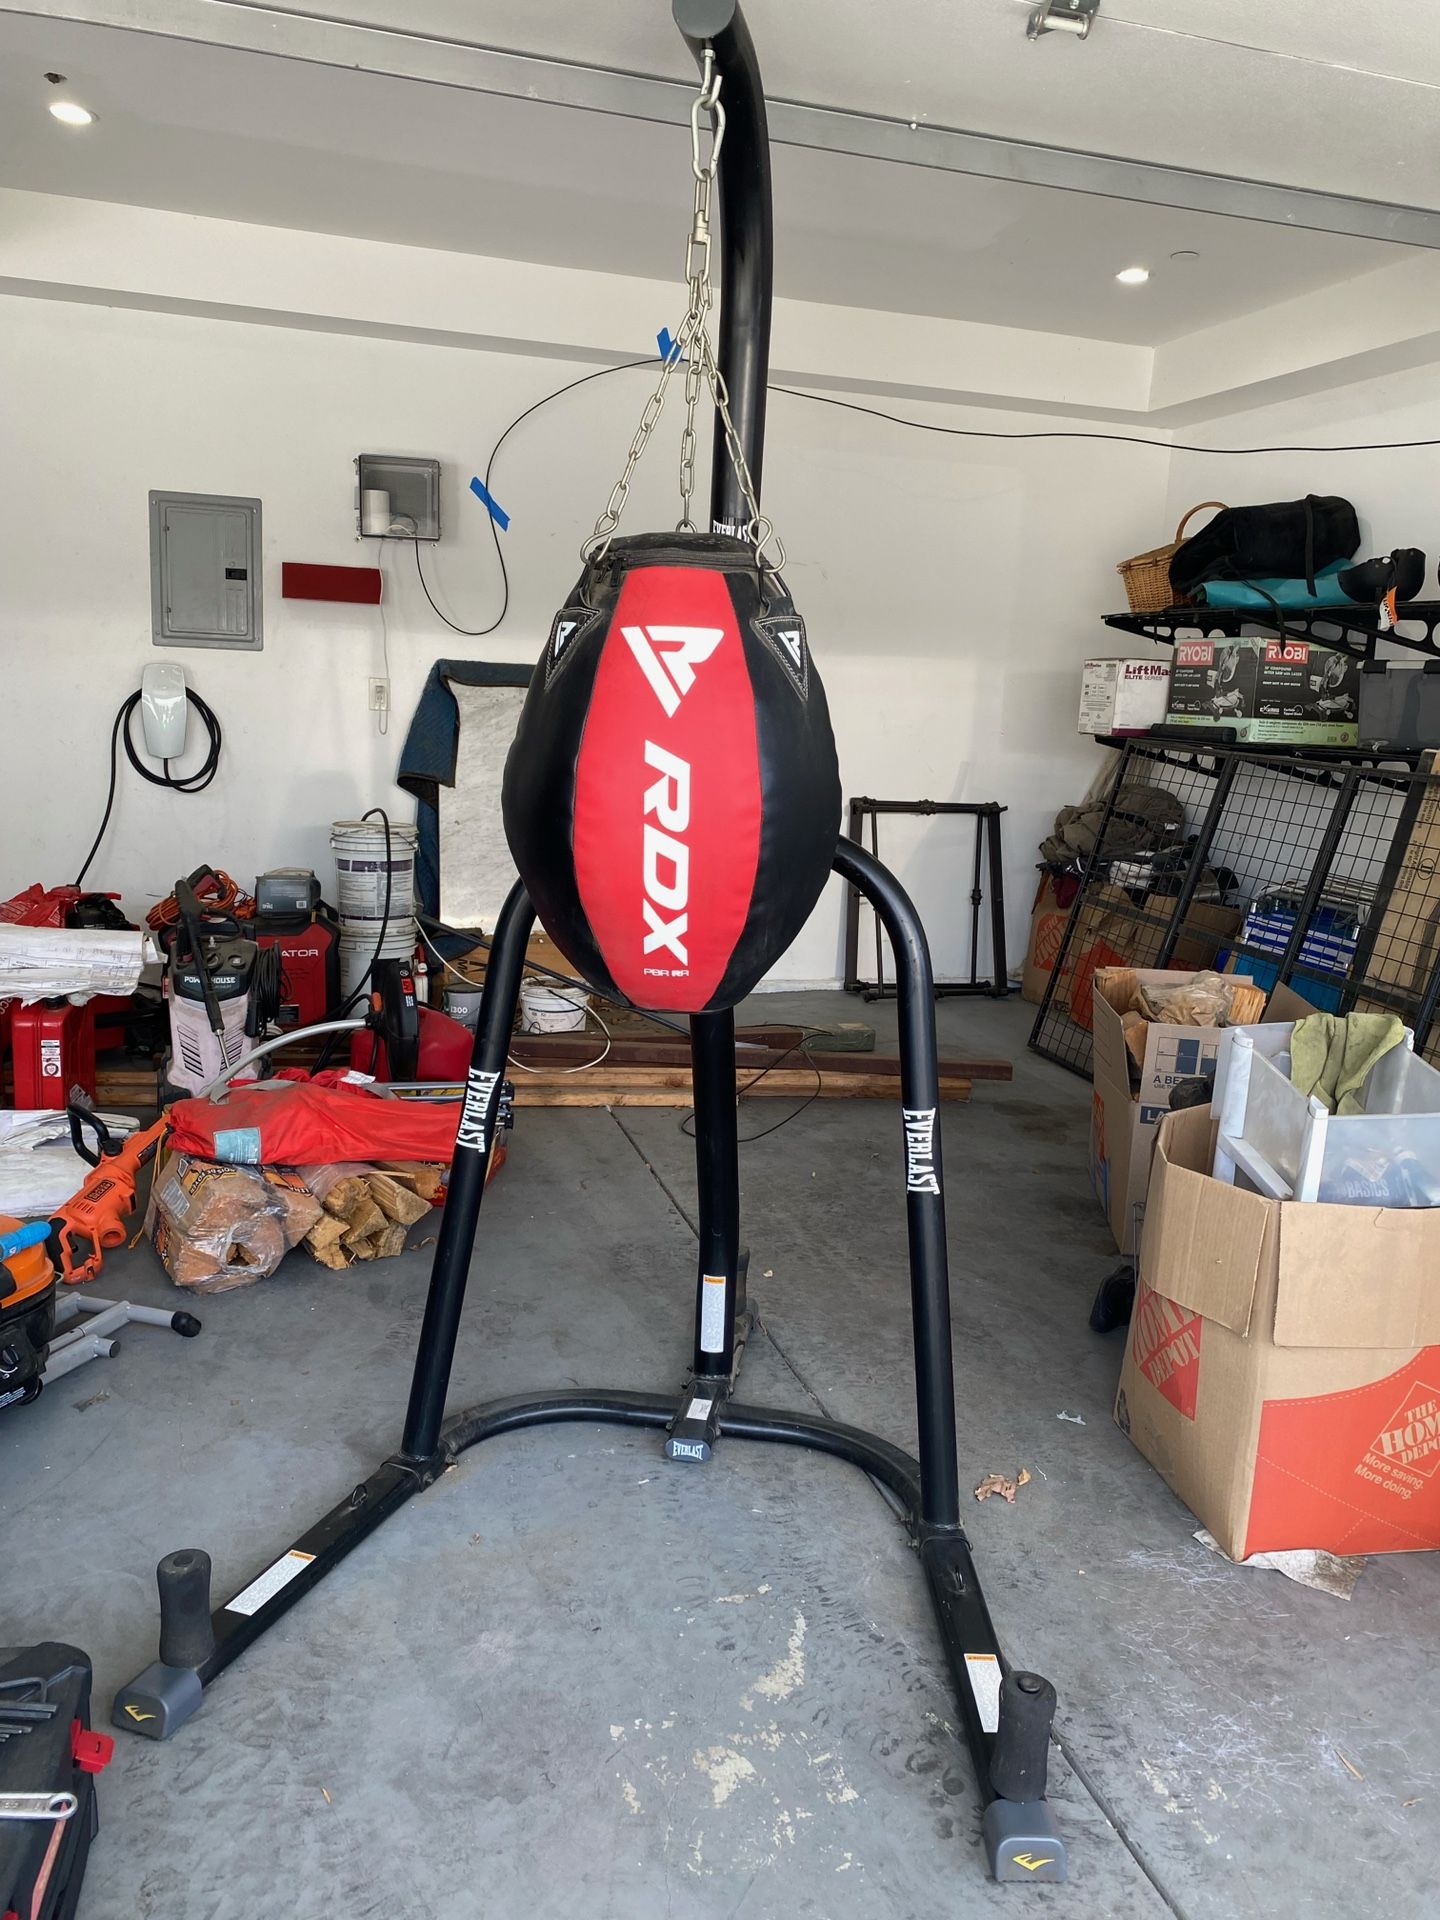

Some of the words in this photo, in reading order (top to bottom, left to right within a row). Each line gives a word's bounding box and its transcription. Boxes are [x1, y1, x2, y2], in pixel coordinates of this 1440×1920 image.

[713, 519, 750, 543] EVERLAS
[1179, 645, 1213, 661] RYOBI
[643, 739, 691, 966] RDX
[281, 949, 319, 957] ATOR
[184, 976, 236, 984] POWHOUSE
[1153, 1075, 1161, 1084] A
[1164, 1075, 1180, 1085] BE
[456, 1065, 500, 1153] EVERLAST
[903, 1107, 940, 1195] EVERLAST
[1148, 1329, 1200, 1388] DEPOT
[1404, 1399, 1438, 1424] THE
[1380, 1411, 1440, 1456] HOM
[672, 1440, 704, 1461] EVERLAST
[1401, 1436, 1440, 1465] DEPO
[1354, 1463, 1382, 1484] More
[1383, 1479, 1412, 1500] doing.
[1362, 1452, 1391, 1473] More
[1391, 1468, 1424, 1490] saving.
